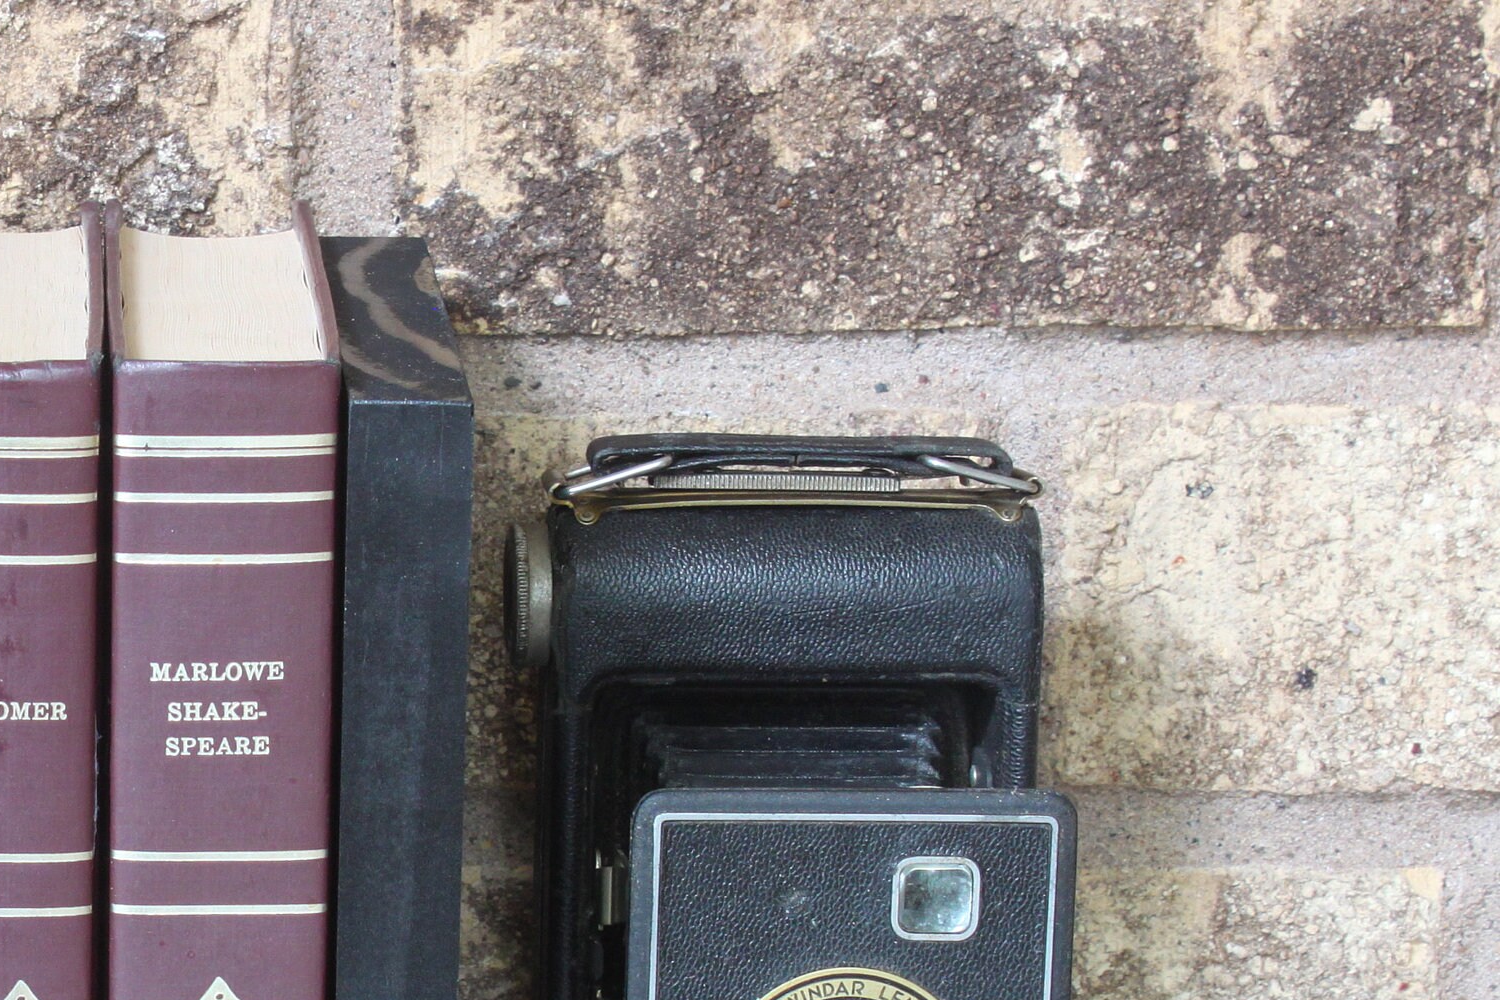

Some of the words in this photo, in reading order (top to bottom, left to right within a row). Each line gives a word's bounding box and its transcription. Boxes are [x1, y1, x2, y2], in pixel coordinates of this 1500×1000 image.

[149, 661, 285, 682] MARLOWE
[167, 701, 268, 722] SHAKE-
[165, 735, 270, 757] SPEARE
